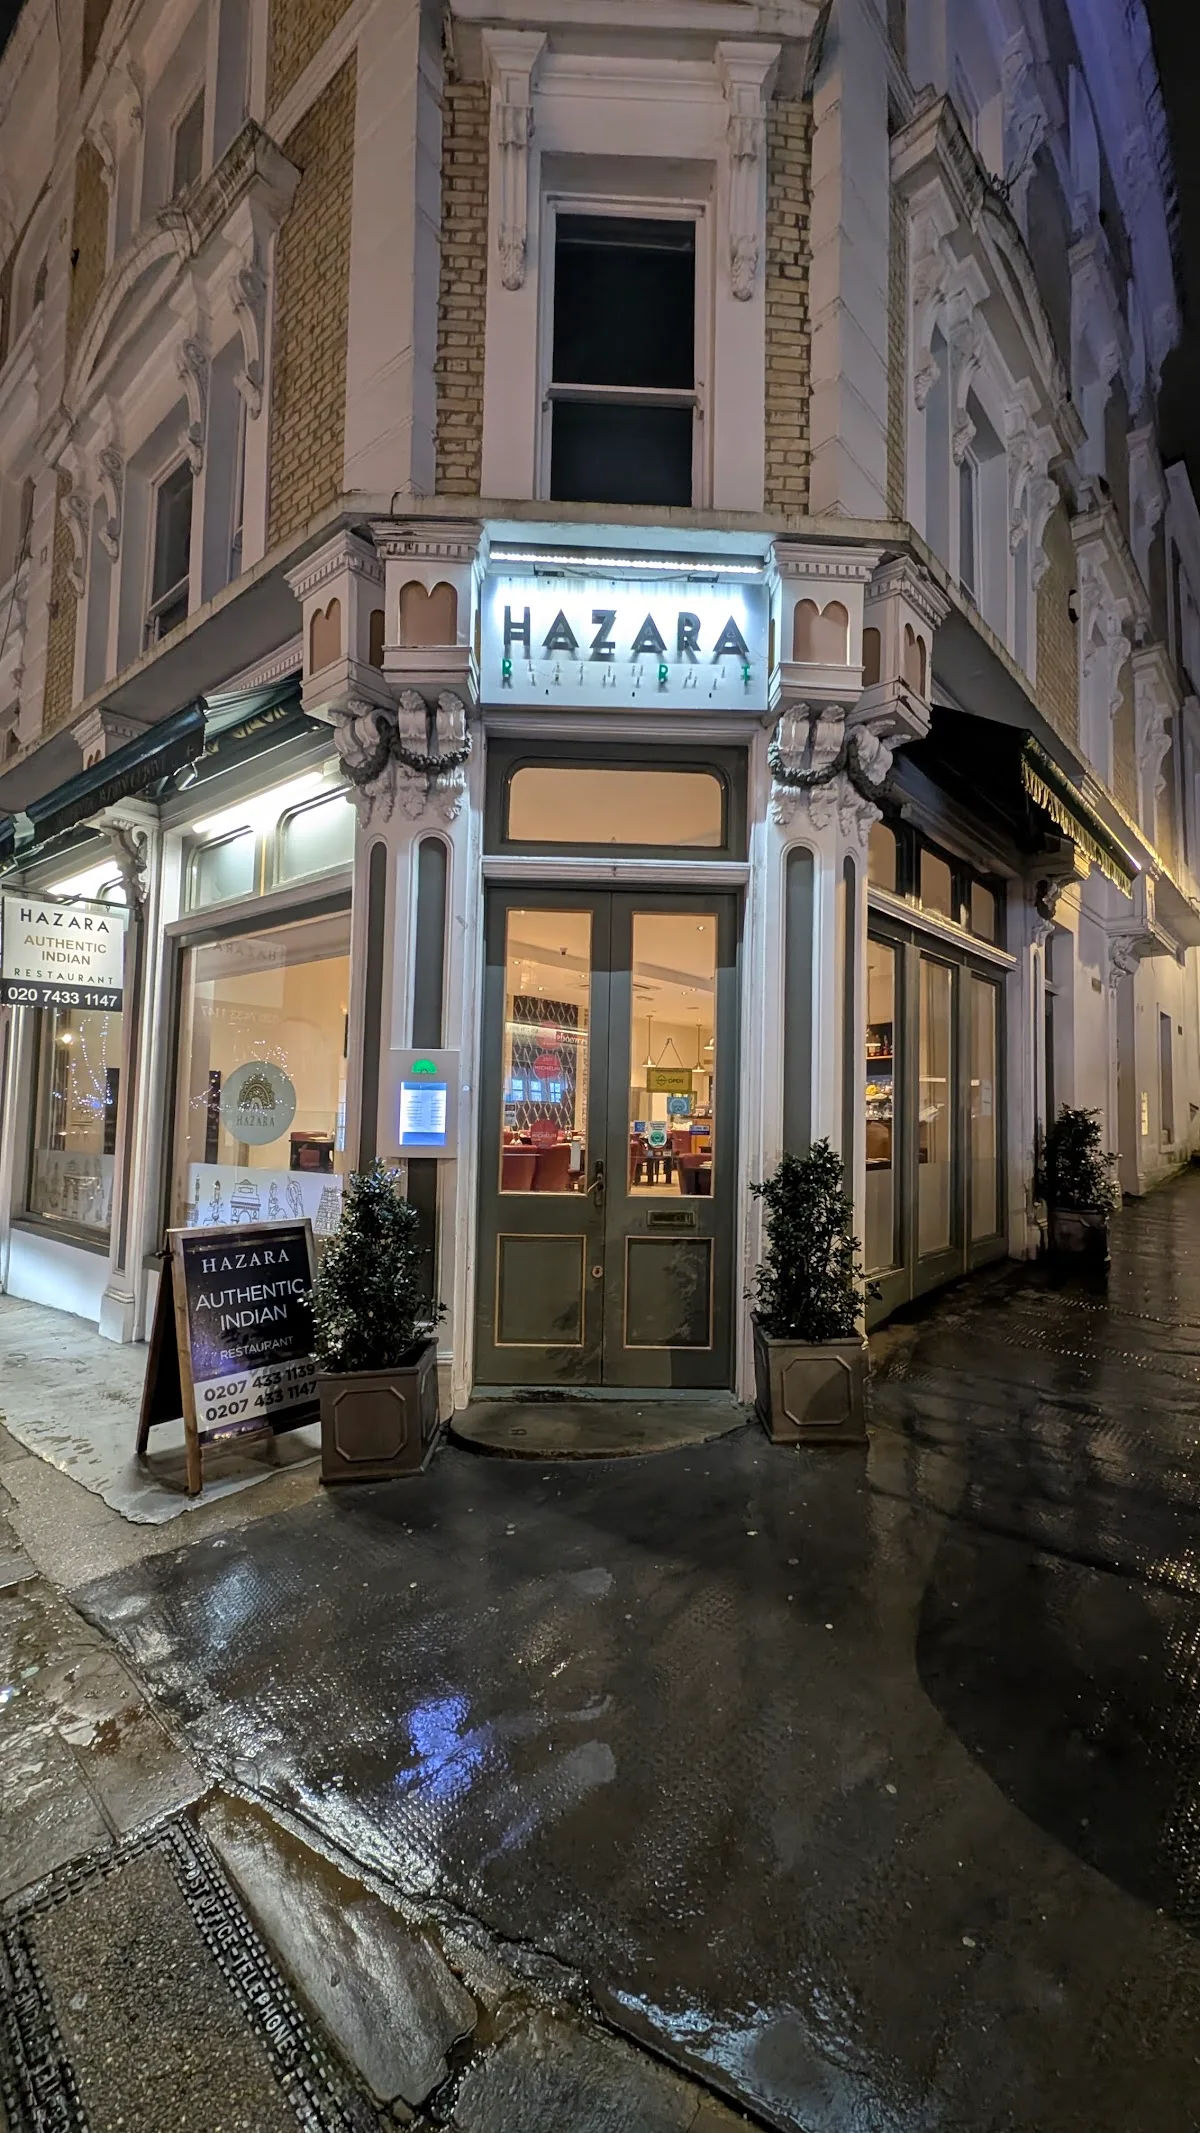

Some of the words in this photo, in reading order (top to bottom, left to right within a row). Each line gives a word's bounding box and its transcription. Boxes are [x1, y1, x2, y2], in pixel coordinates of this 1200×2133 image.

[503, 605, 750, 653] HAZARA
[20, 908, 110, 933] HAZARA
[24, 935, 107, 954] AUTHENTIC
[42, 951, 91, 965] INDIAN
[14, 967, 113, 985] RESTAURANT
[8, 987, 38, 1001] 020
[42, 990, 79, 1004] 7433
[84, 993, 118, 1007] 1147
[236, 1115, 275, 1127] HAZARA
[201, 1248, 290, 1274] HAZARA
[195, 1278, 305, 1312] AUTHENTIC
[220, 1304, 288, 1331] INDIAN
[220, 1336, 294, 1360] RESTAURANT
[204, 1380, 247, 1401] 0207
[252, 1371, 282, 1389] 433
[286, 1363, 315, 1381] 1139
[206, 1398, 249, 1421] 0207
[254, 1390, 283, 1408] 433
[287, 1380, 317, 1398] 1147
